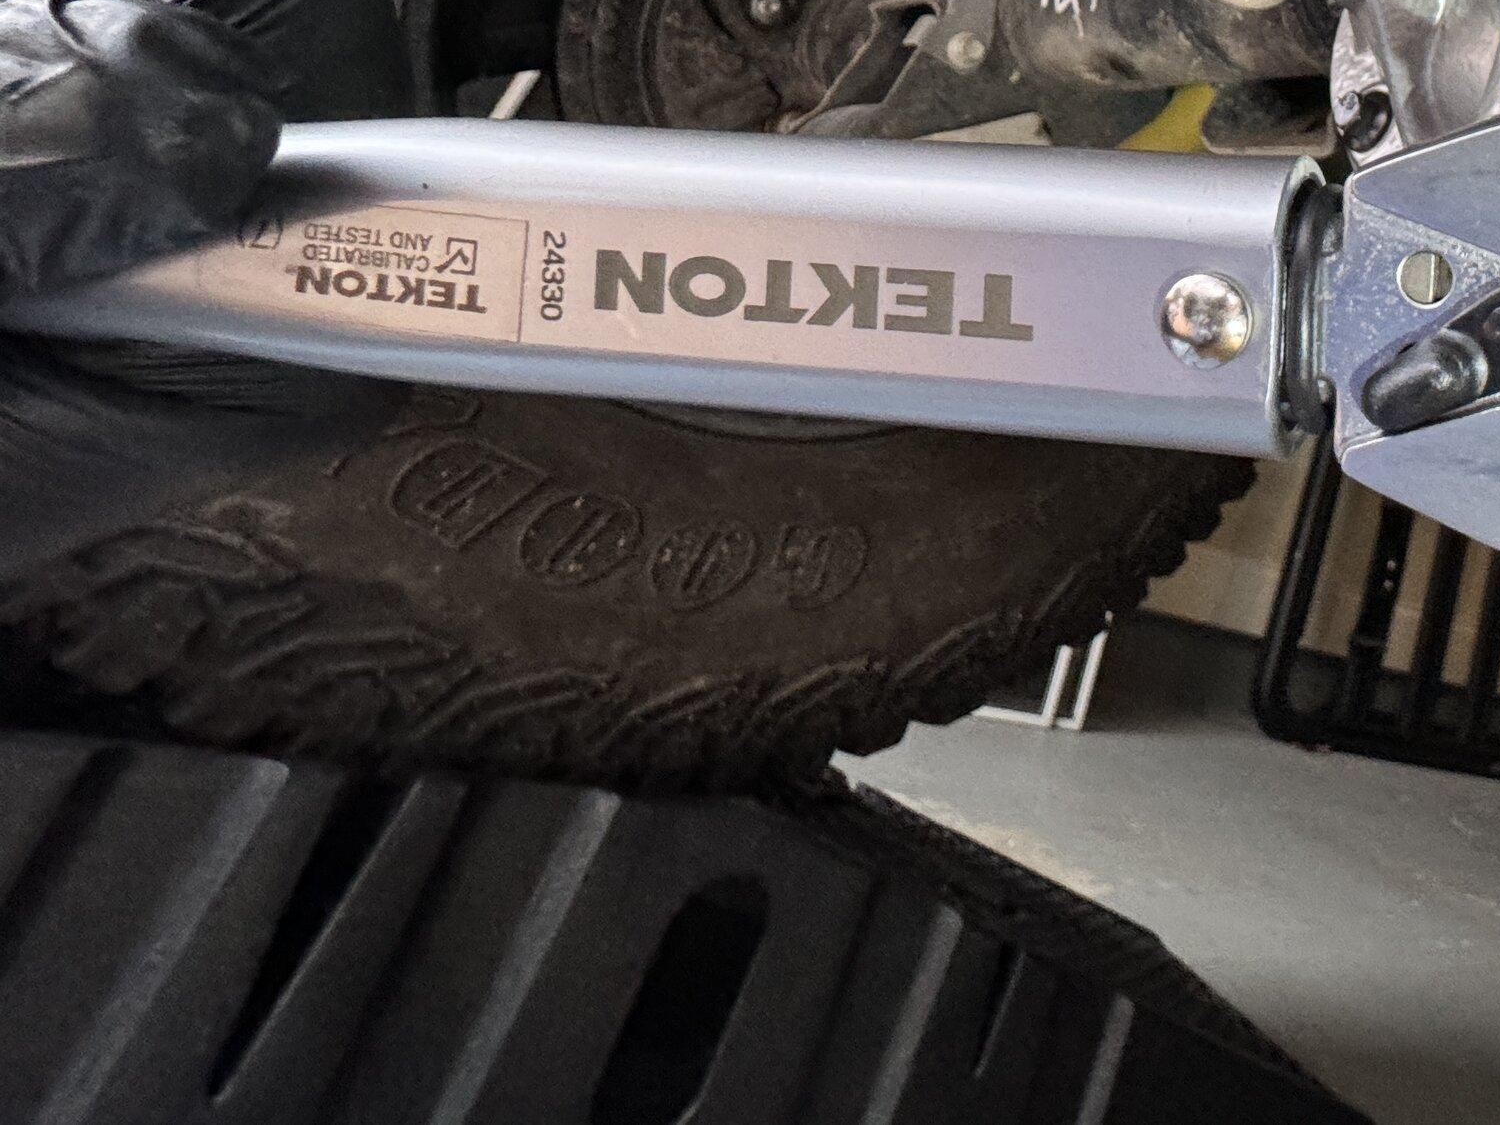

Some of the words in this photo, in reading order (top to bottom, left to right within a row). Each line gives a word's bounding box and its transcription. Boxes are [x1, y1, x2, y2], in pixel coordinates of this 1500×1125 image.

[304, 223, 382, 247] TESTED
[389, 231, 433, 251] AND
[302, 243, 430, 272] CALIBRATED
[540, 229, 567, 322] 24330
[295, 265, 487, 314] TEKTON
[594, 249, 1034, 342] TEKTON
